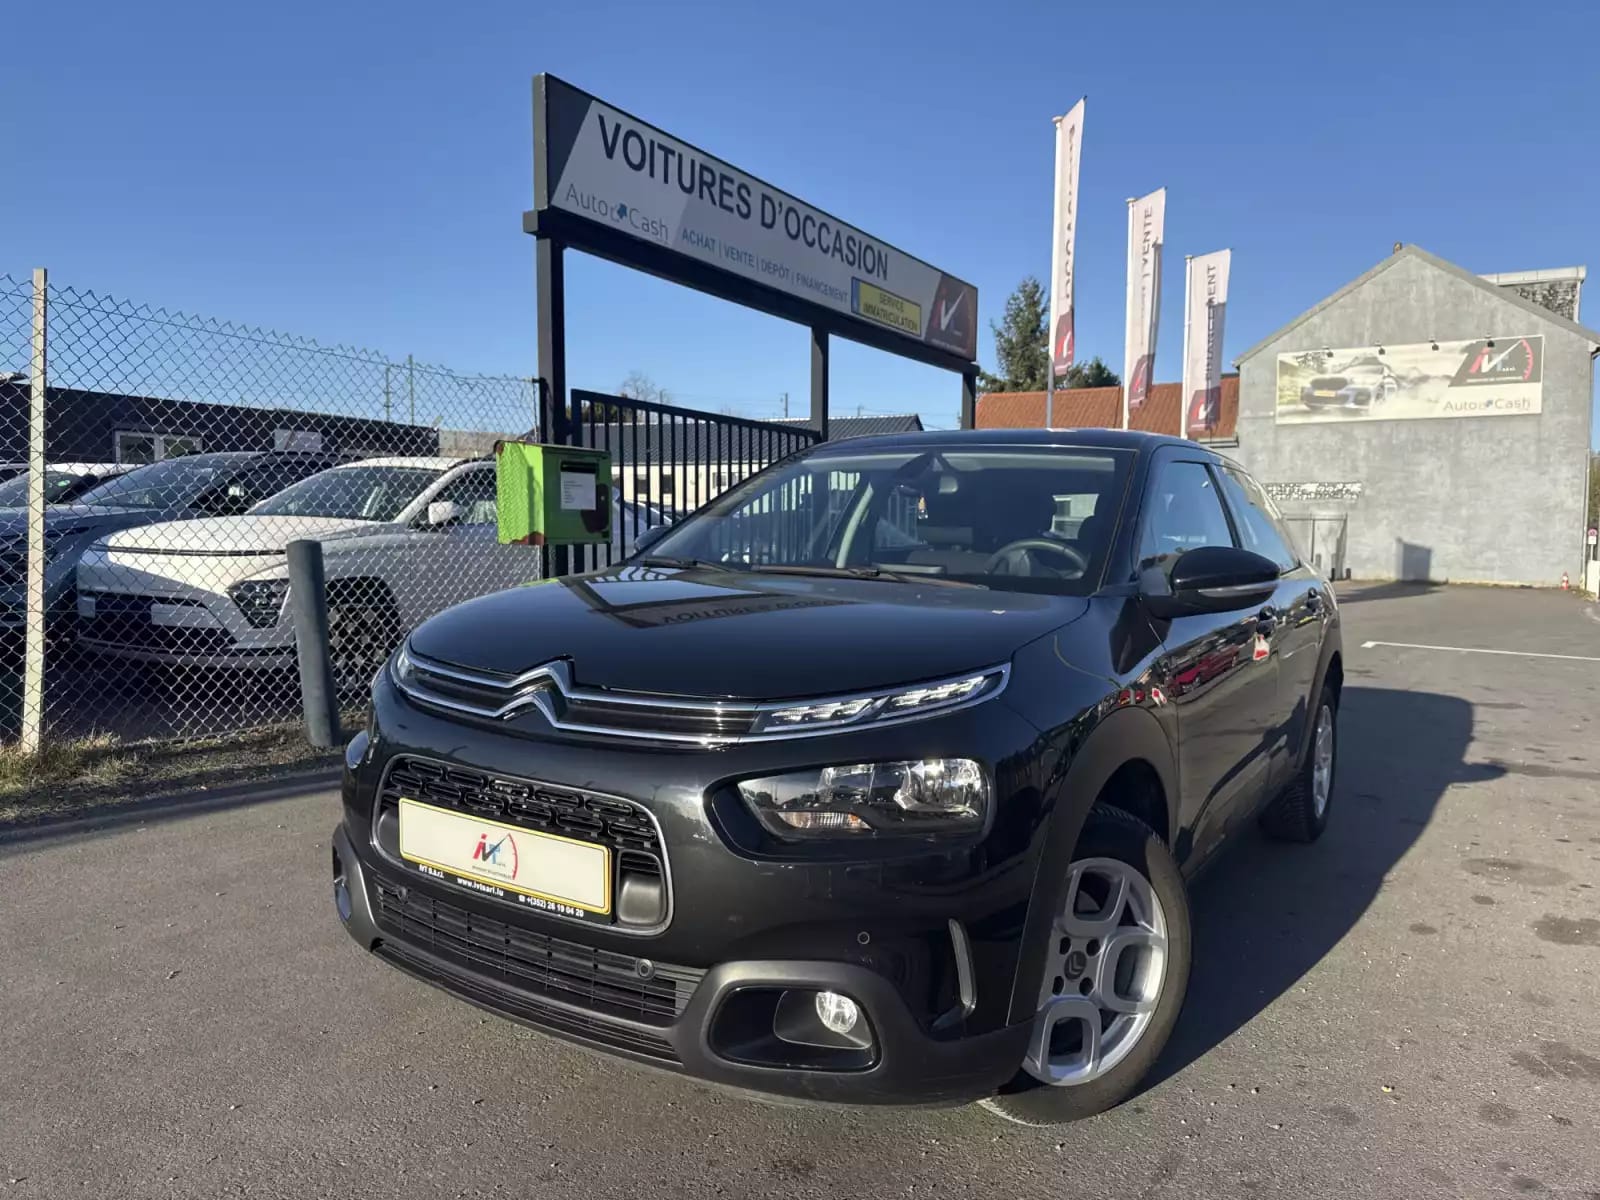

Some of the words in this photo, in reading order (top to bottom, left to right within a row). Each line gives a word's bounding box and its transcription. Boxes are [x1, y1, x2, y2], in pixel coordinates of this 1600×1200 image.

[598, 113, 751, 220] VOITURES
[566, 183, 608, 217] Auto
[629, 207, 668, 241] Cash
[682, 228, 716, 251] ACHAT
[724, 246, 754, 268] VENTE
[796, 272, 848, 302] FINANCEMENT
[1443, 400, 1478, 412] Auto
[1494, 397, 1531, 410] Cash
